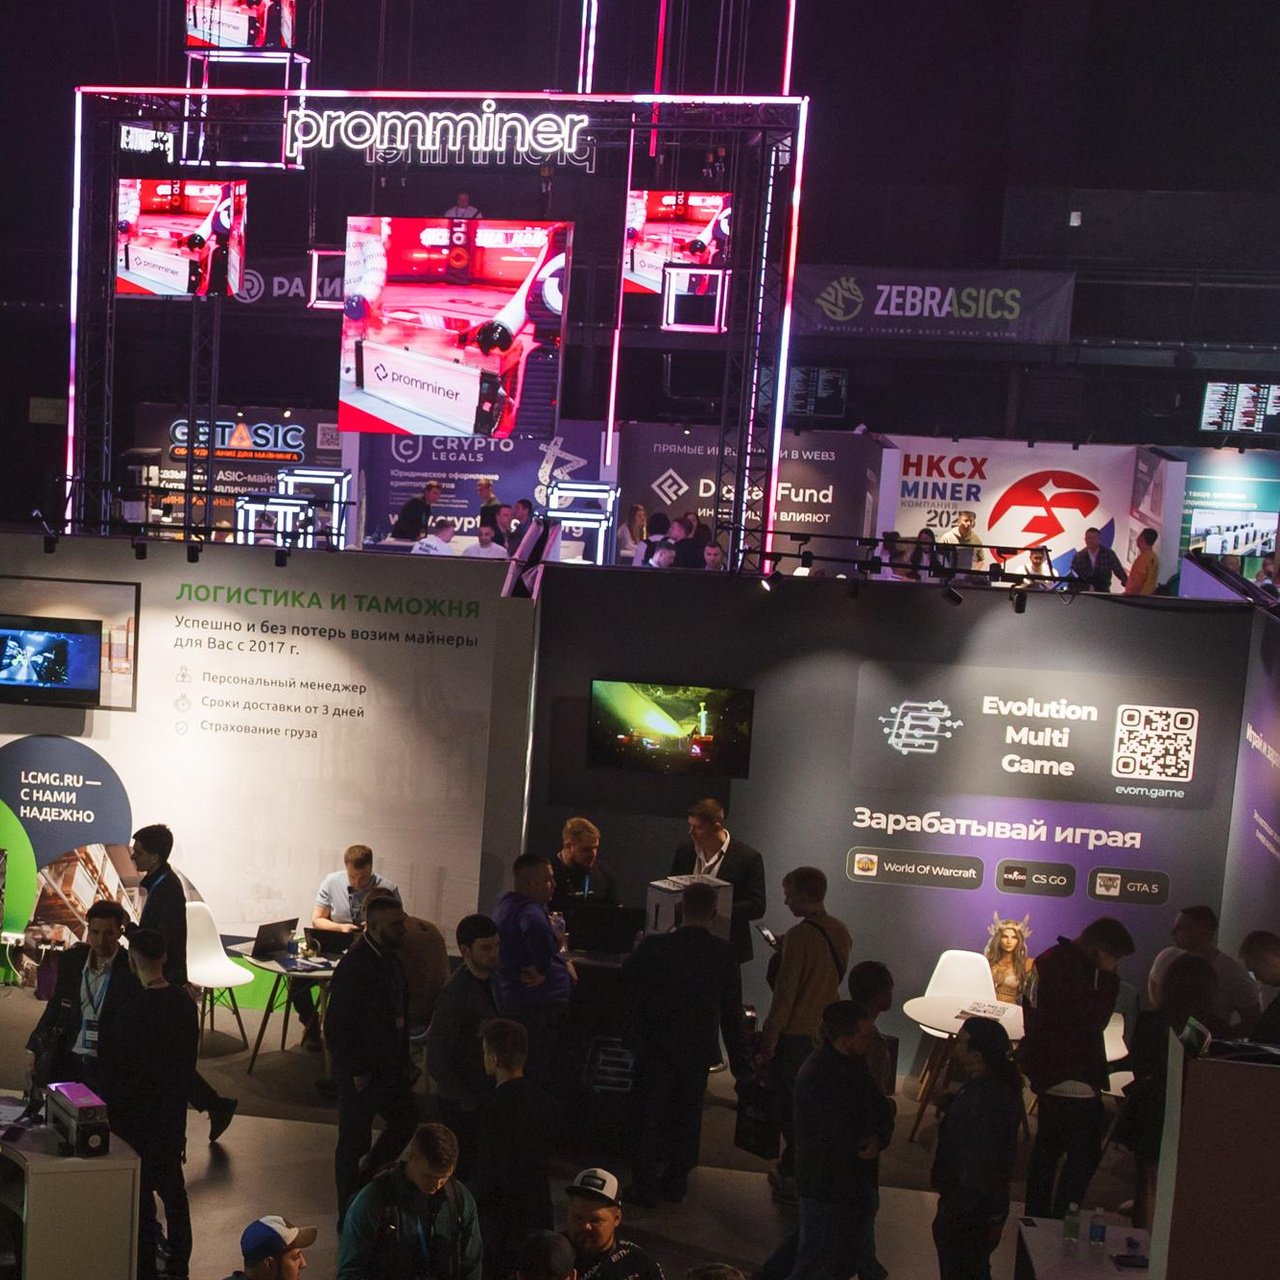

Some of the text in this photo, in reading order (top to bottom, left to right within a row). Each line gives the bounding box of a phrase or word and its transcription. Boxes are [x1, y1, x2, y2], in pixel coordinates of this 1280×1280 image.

[286, 99, 589, 157] promminer
[874, 284, 1021, 319] ZEBRASICS
[391, 370, 461, 402] promminer
[432, 437, 514, 452] CRYPTO
[653, 443, 704, 455] ПРЯМЫЕ
[432, 452, 484, 462] LEGALS
[390, 469, 447, 479] Юридическое
[903, 454, 988, 480] HKCX
[777, 482, 833, 504] Fund
[901, 480, 981, 502] MINER
[901, 500, 958, 509] КОМПАНИЯ
[780, 512, 831, 523] ВЛИЯЮТ
[926, 510, 976, 528] 202
[175, 583, 480, 618] ЛОГИСТИКА И ТАМОЖНЯ
[175, 615, 478, 648] Успешно и без потерь возим майнеры
[173, 637, 300, 656] для Вас с 2017 г.
[202, 672, 367, 696] Персональный менеджер
[201, 696, 365, 719] Сроки доставки от 3 дней
[982, 695, 1098, 721] Evolution
[200, 720, 318, 740] Страхование груза
[1006, 726, 1069, 748] Multi
[1001, 754, 1075, 777] Game
[21, 771, 84, 787] LCMG.RU
[20, 788, 77, 804] С НАМИ
[1116, 785, 1185, 799] evom.game
[20, 806, 95, 823] НАДЕЖНО
[853, 807, 1142, 850] Зарабатывай играя
[884, 862, 977, 879] World Of Warcraft
[1032, 874, 1066, 885] CS GO
[1127, 882, 1159, 893] GTA 5
